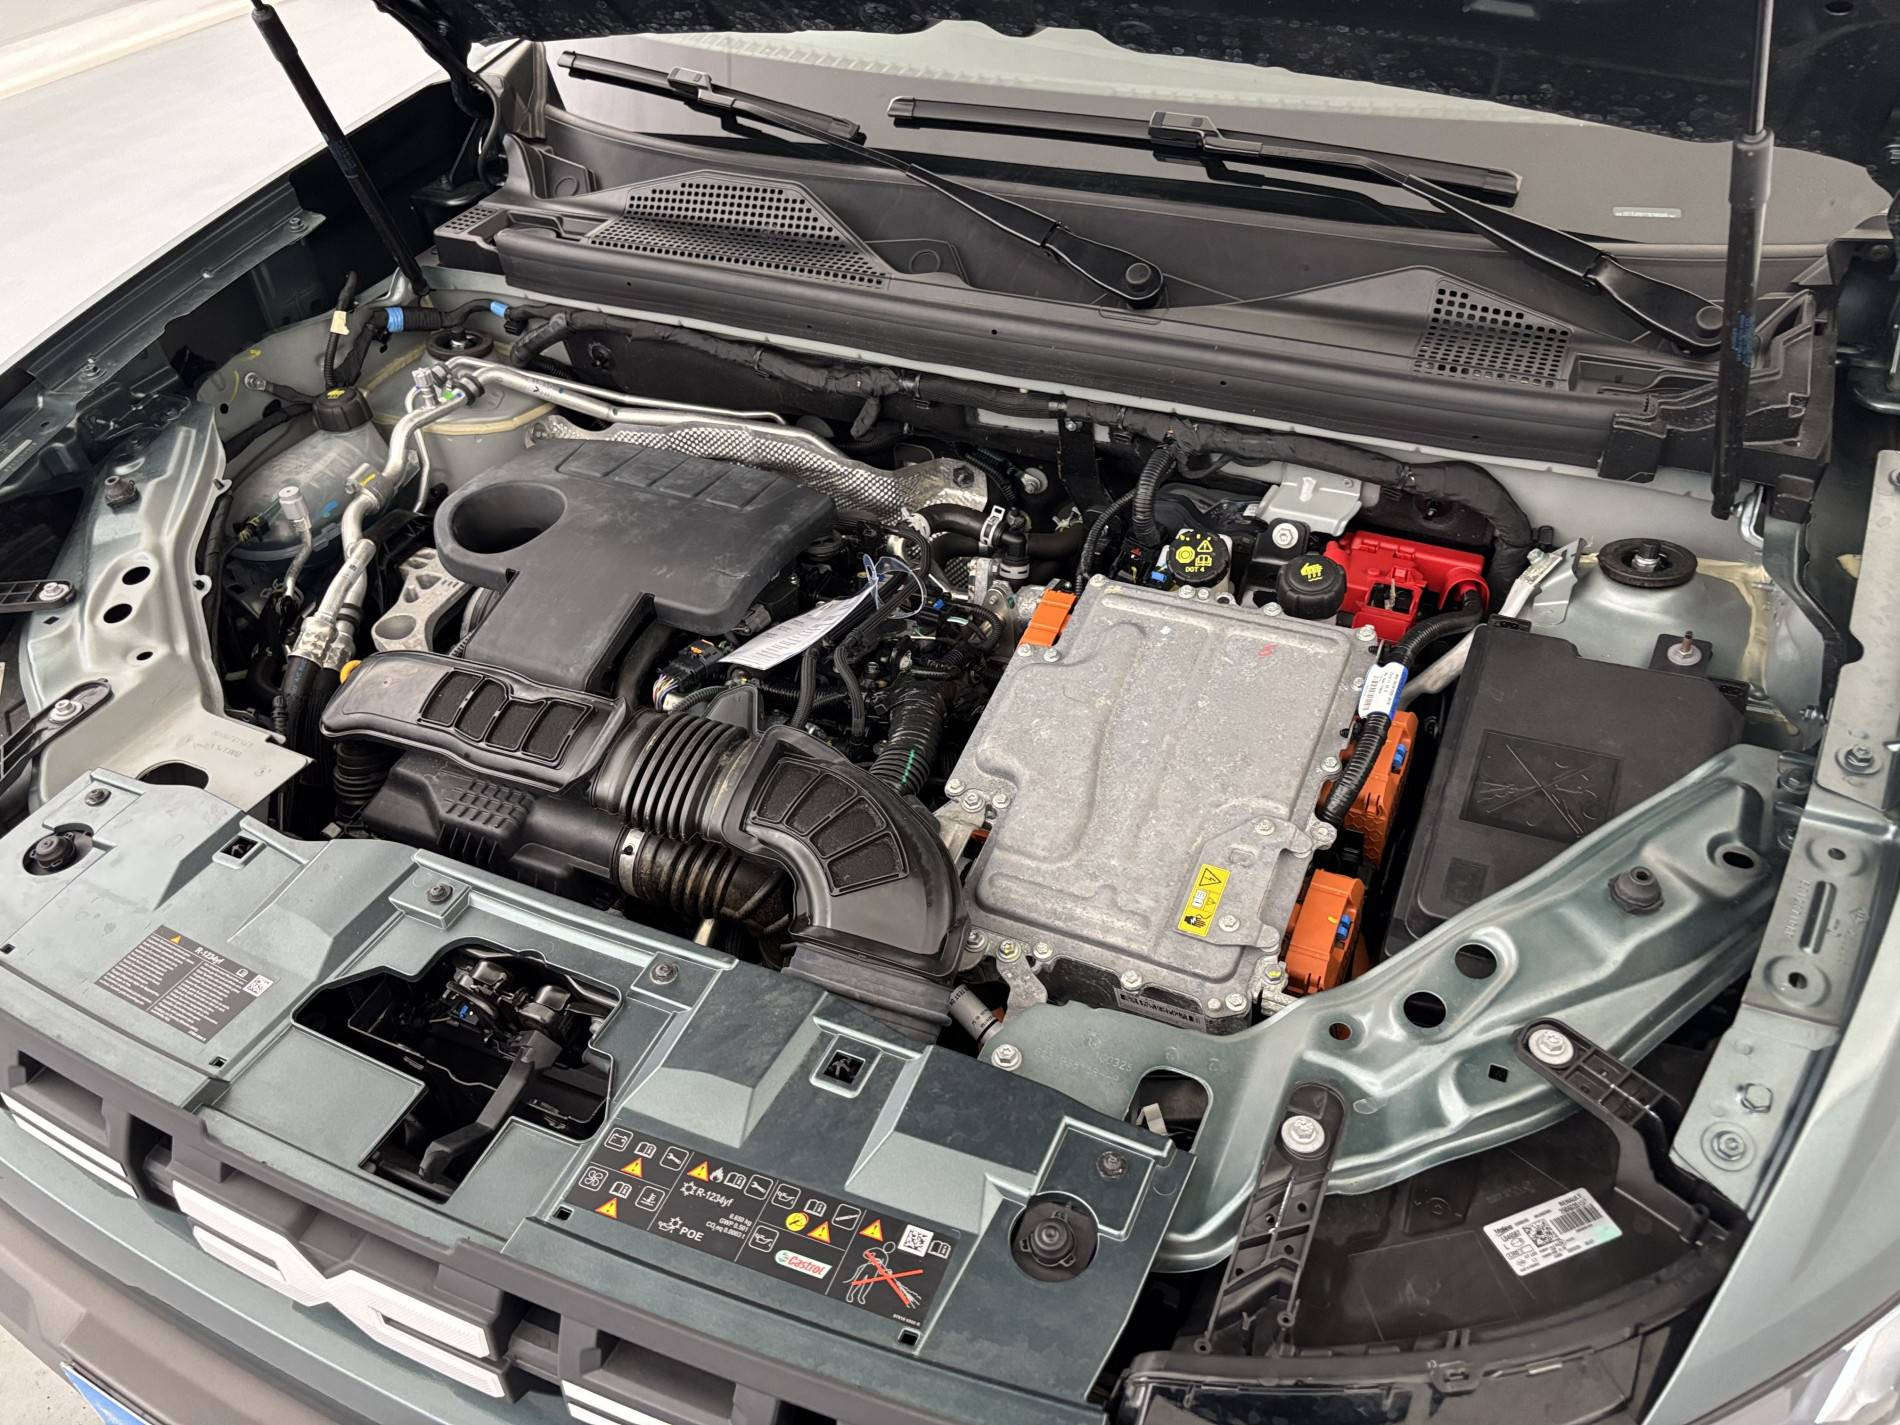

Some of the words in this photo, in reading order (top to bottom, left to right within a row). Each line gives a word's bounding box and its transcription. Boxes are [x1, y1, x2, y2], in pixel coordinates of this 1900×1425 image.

[696, 1187, 734, 1207] R-1234yf
[719, 1217, 734, 1227] GWP
[680, 1226, 705, 1242] POE
[788, 1255, 826, 1275] Castrol
